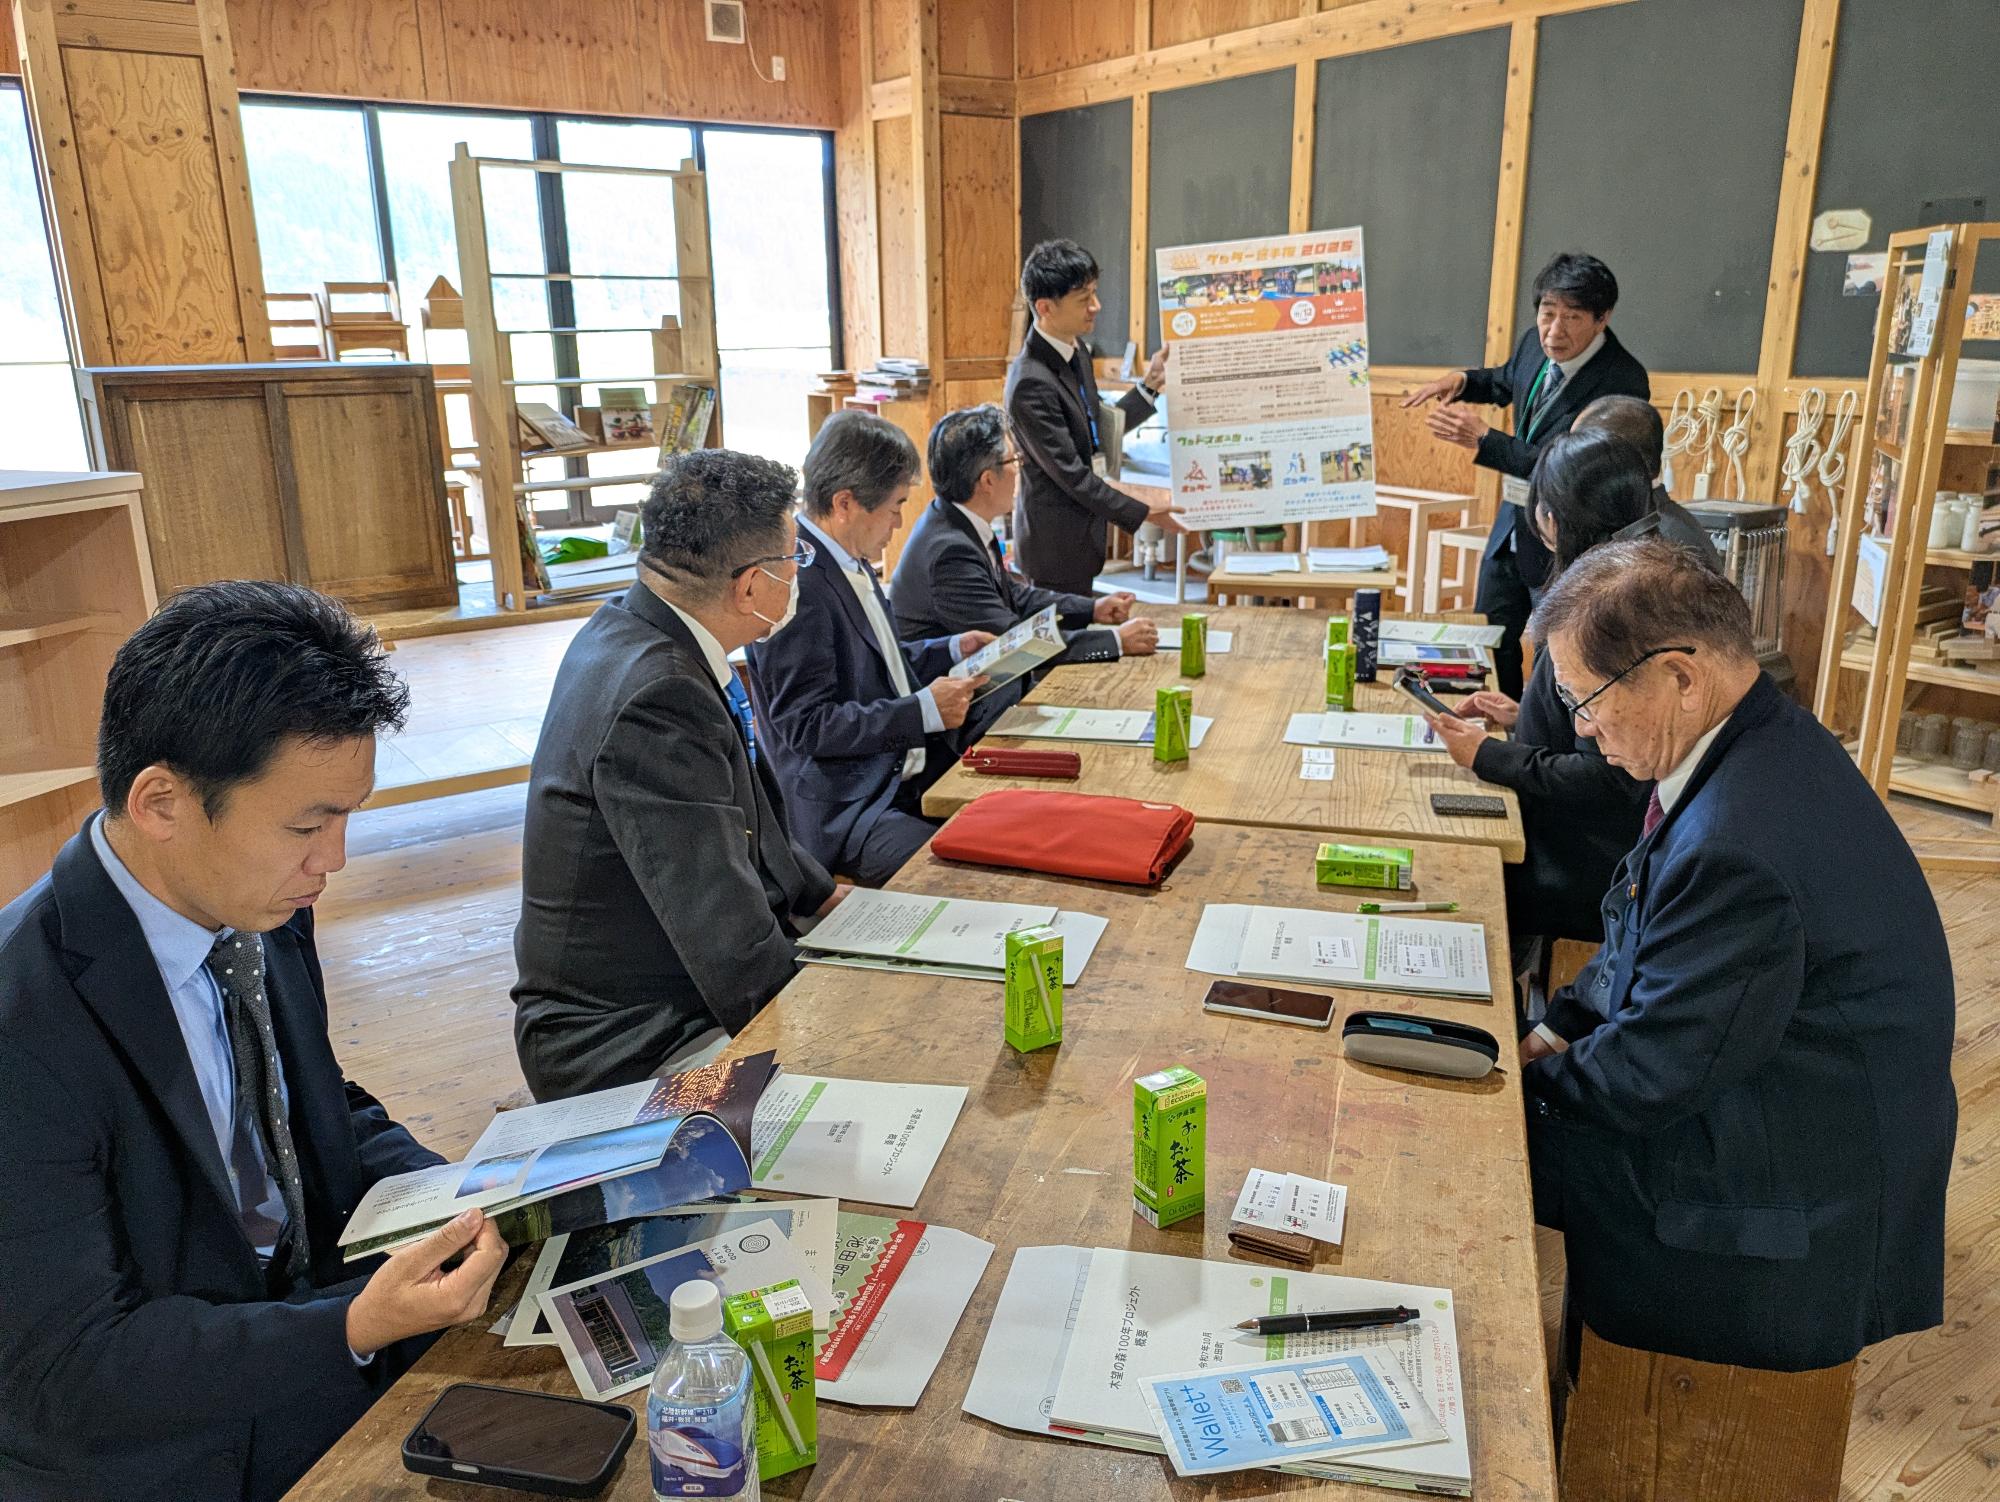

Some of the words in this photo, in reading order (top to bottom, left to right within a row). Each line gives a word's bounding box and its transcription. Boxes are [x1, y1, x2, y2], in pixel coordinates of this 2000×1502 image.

[1301, 239, 1353, 257] 2025
[1170, 1140, 1194, 1185] お茶
[711, 1247, 726, 1265] LABO
[722, 1243, 737, 1261] WOOD
[833, 1235, 867, 1278] 池田町
[860, 1236, 880, 1261] 福井県
[1109, 1285, 1140, 1390] 木望の森100年プロジェクト
[1134, 1328, 1150, 1349] 概要
[1198, 1331, 1214, 1369] 令和7年10月
[1213, 1341, 1225, 1363] 池田町
[784, 1355, 810, 1390] お茶
[1382, 1374, 1404, 1400] 八十二銀行
[662, 1406, 694, 1416] 北陸新幹線
[1180, 1385, 1230, 1459] Wallet+
